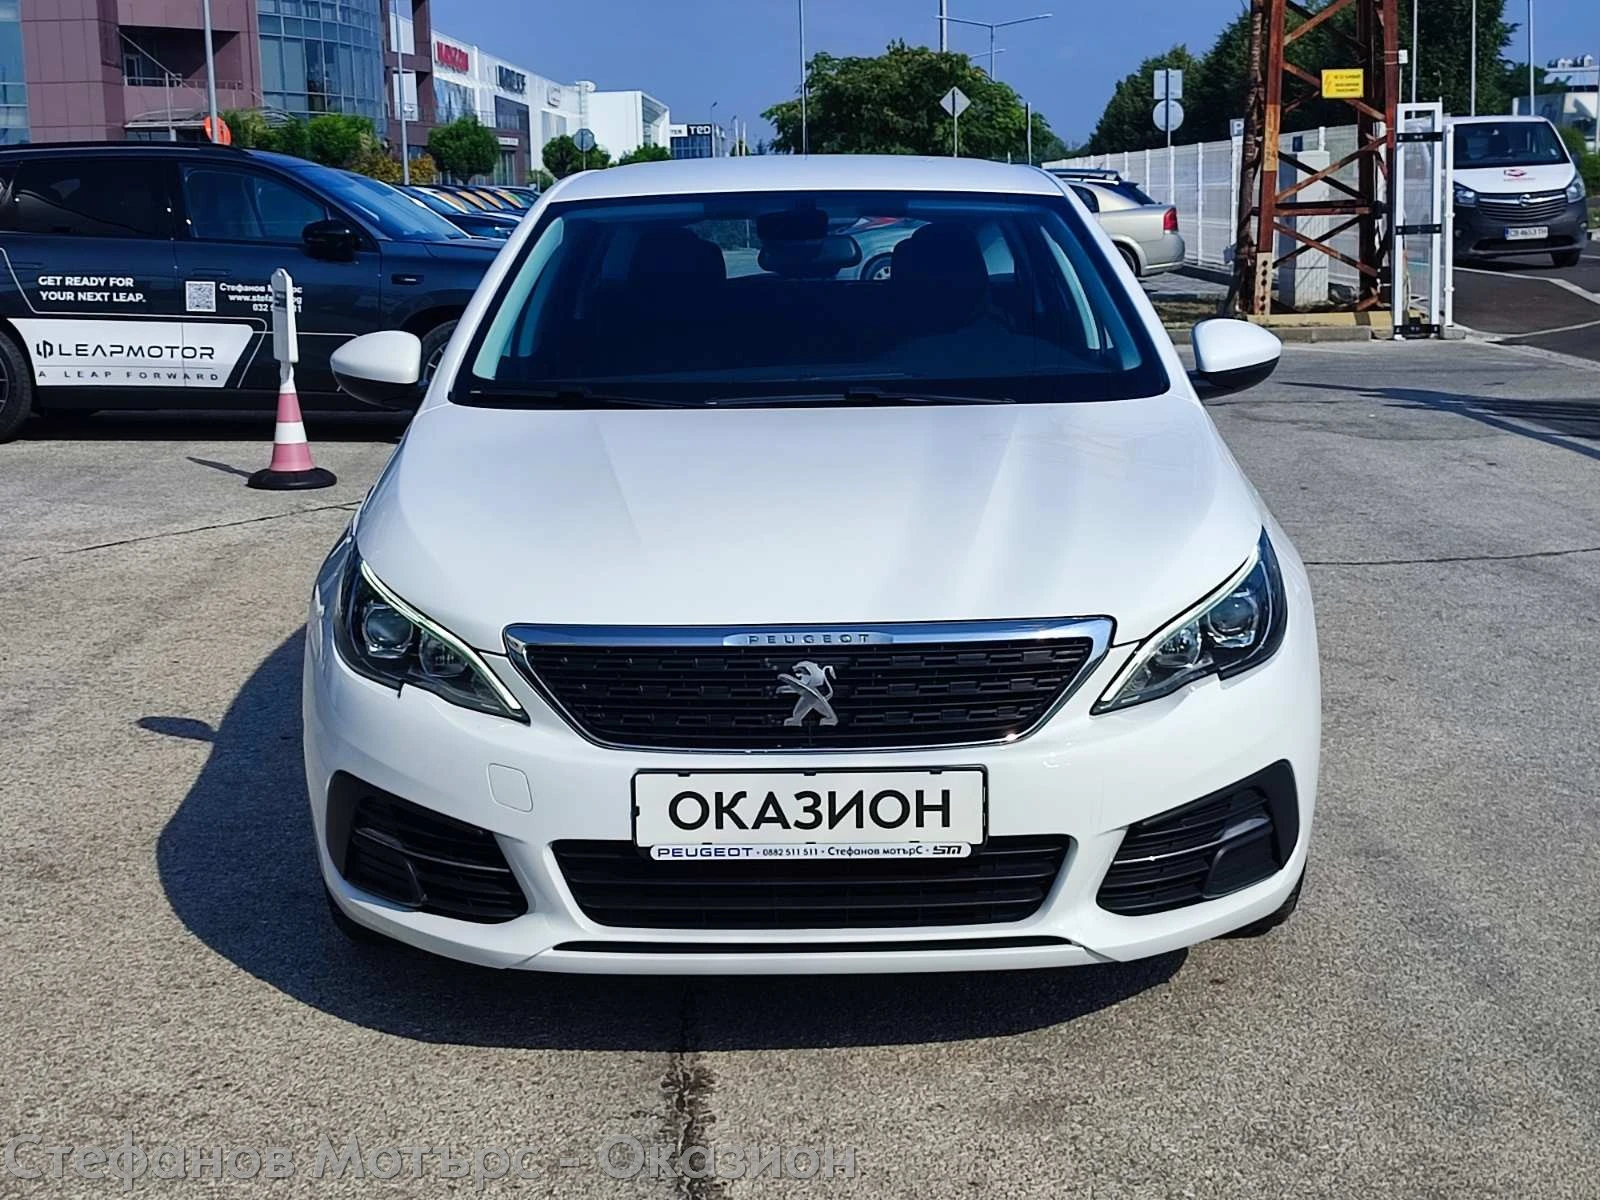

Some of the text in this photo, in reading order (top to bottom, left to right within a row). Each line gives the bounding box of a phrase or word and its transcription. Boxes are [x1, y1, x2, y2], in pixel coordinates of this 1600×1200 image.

[38, 276, 134, 288] GET READY FOR
[219, 282, 266, 293] Стефанов
[40, 291, 146, 303] YOUR NEXT LEAP.
[58, 343, 214, 360] LEAPMOTOR
[64, 370, 112, 378] LEAP
[126, 371, 218, 381] FORWARD
[748, 634, 870, 644] PEUGEOT
[668, 789, 950, 830] ОКАЗИОН
[658, 848, 754, 858] PEUGEOT
[762, 848, 785, 857] 0882
[786, 848, 800, 857] 511
[802, 848, 818, 856] 511
[828, 846, 880, 858] Стефанов
